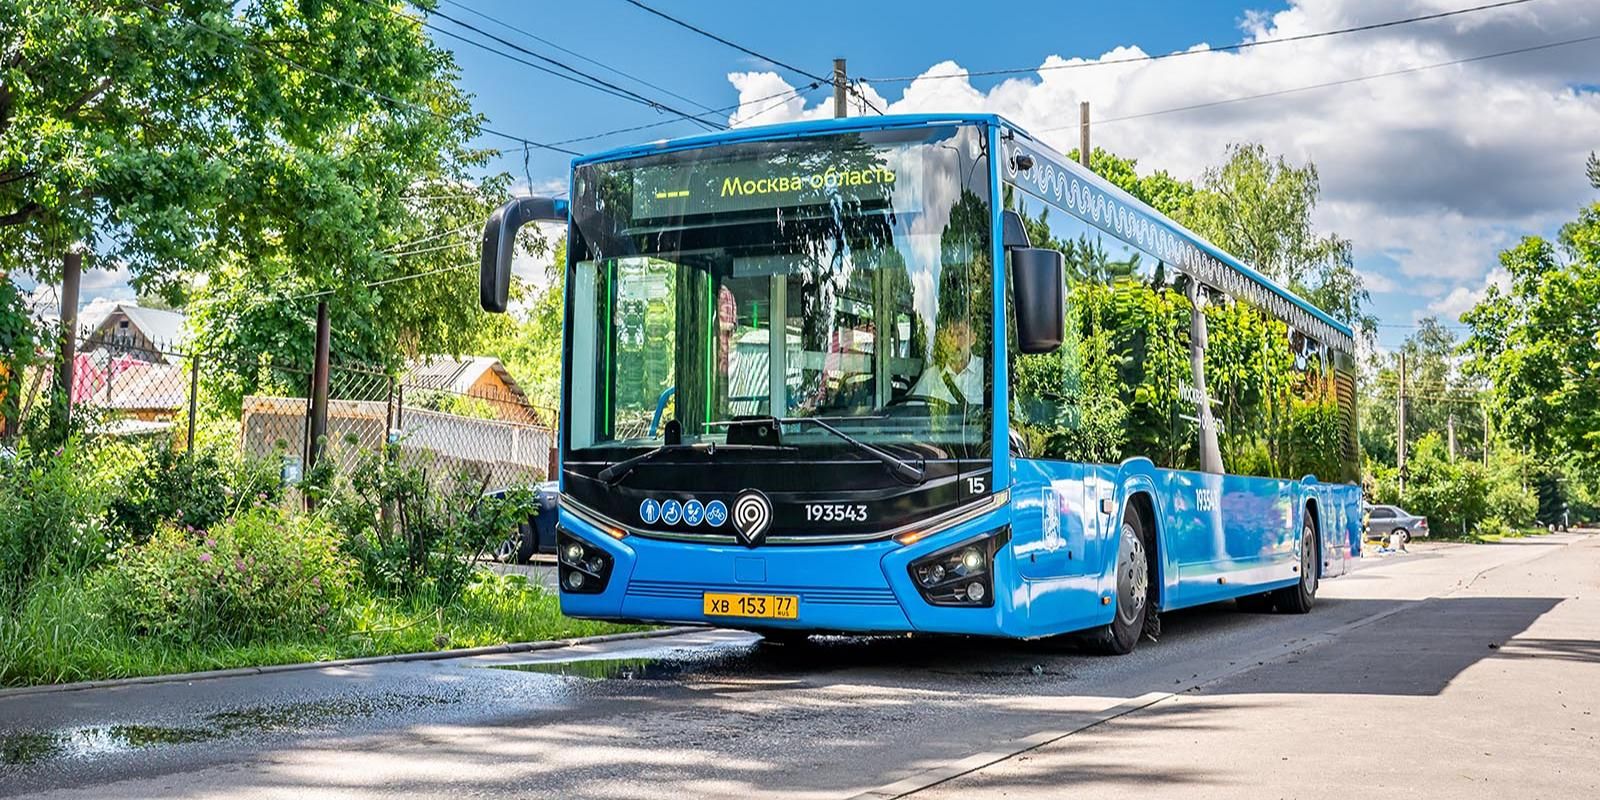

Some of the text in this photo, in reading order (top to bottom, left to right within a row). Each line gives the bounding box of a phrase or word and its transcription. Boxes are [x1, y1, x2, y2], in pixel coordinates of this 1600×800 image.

[721, 167, 896, 197] Москва область
[967, 477, 985, 494] 15
[805, 504, 868, 521] 193543
[711, 597, 791, 614] ХВ 153 77
